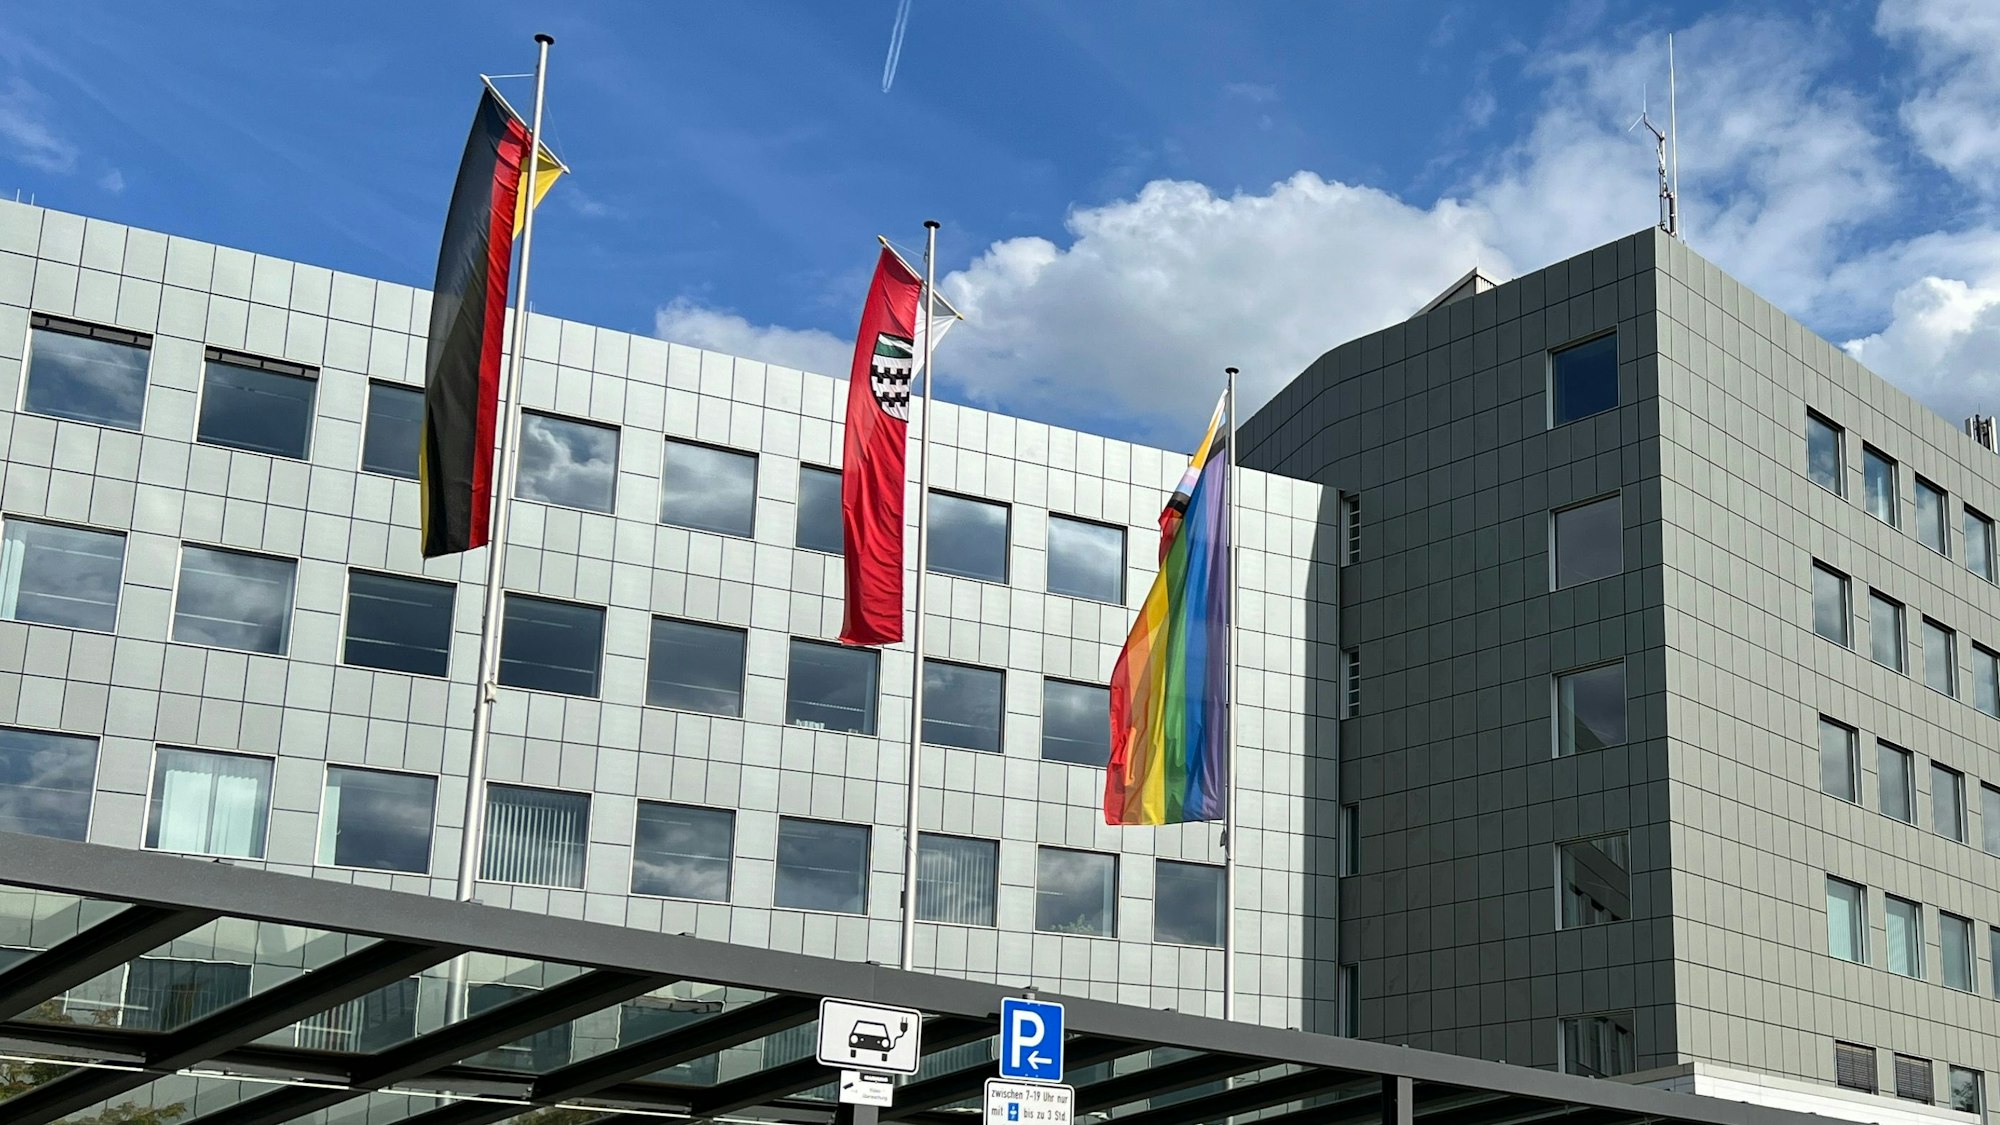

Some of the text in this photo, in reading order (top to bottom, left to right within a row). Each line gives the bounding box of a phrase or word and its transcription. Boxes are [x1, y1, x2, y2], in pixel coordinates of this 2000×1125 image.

[1011, 1009, 1045, 1068] P
[991, 1089, 1023, 1099] zwischen
[1026, 1090, 1041, 1101] 7-19
[1043, 1092, 1054, 1102] Uhr
[991, 1106, 1003, 1116] mit
[1024, 1108, 1034, 1119] bis
[1037, 1111, 1045, 1119] zu
[1047, 1110, 1052, 1120] 3
